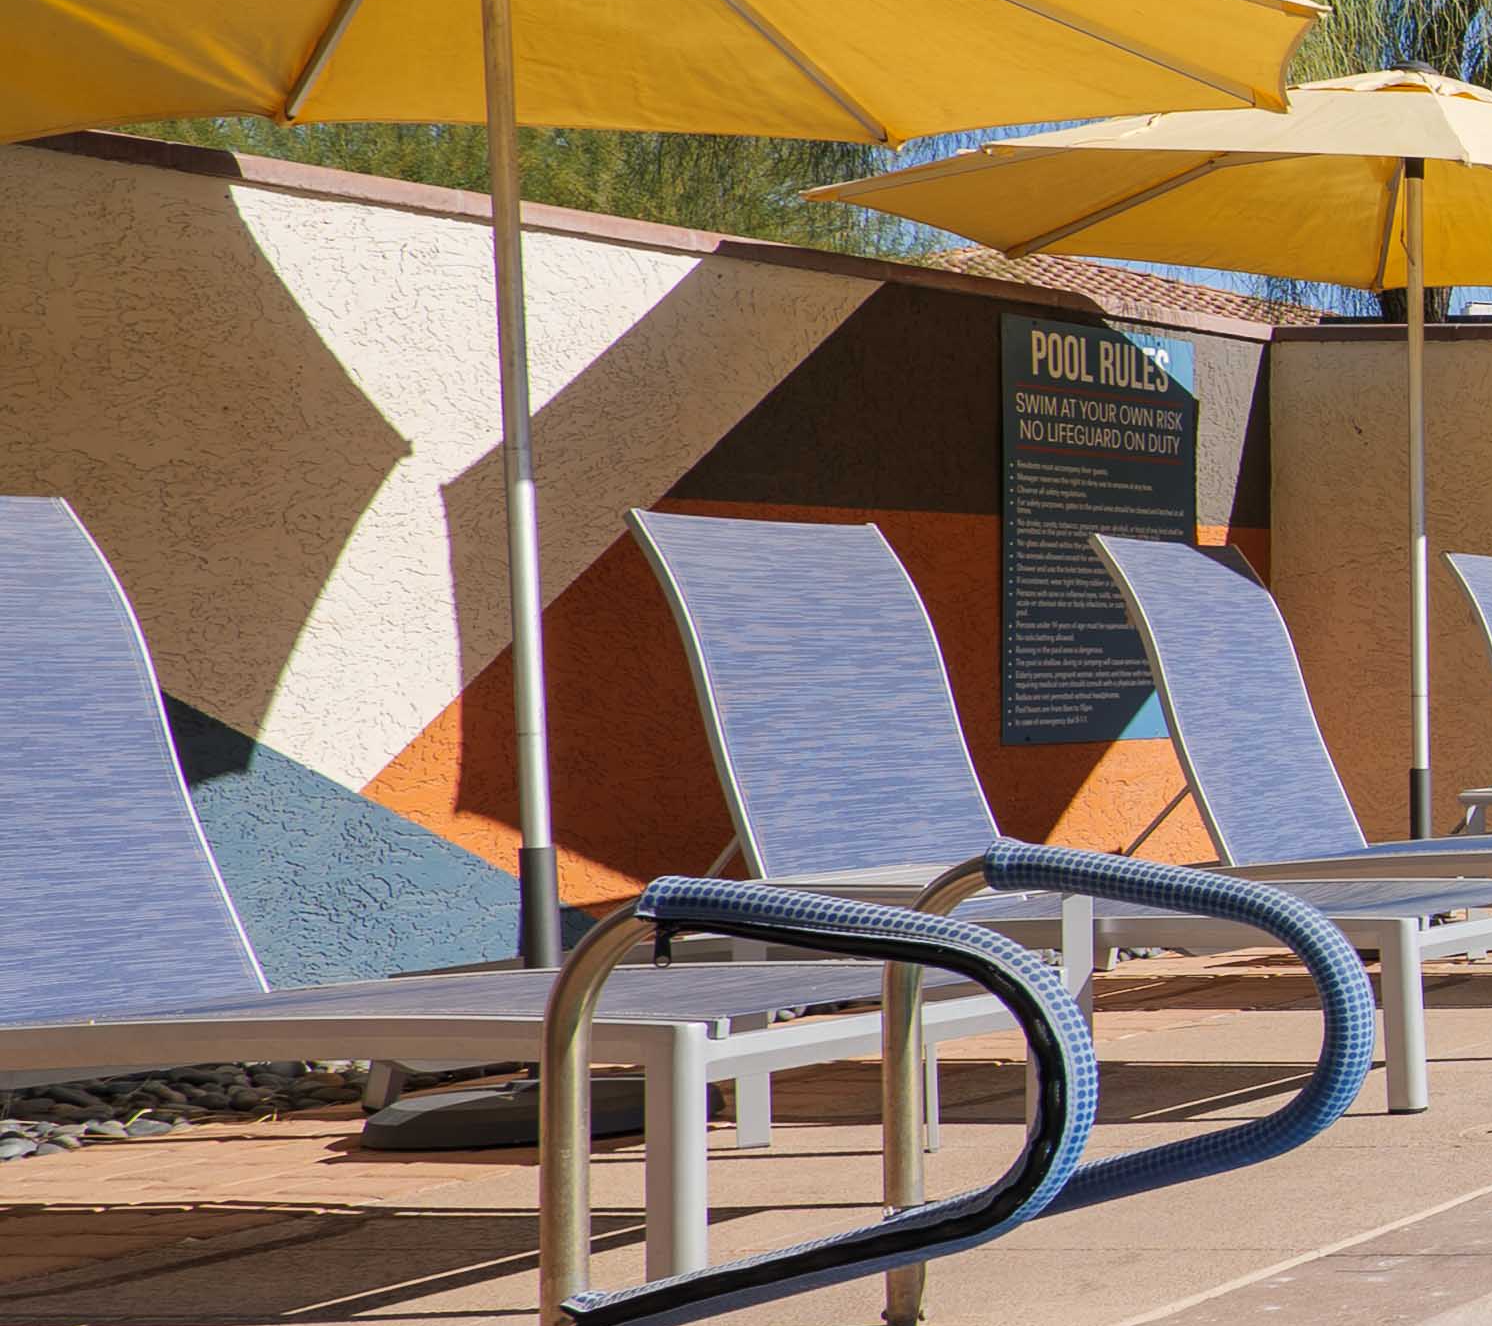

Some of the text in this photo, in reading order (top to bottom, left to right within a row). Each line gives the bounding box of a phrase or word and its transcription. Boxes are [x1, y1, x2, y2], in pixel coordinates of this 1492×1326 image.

[1031, 330, 1169, 393] POOL RULES
[1016, 392, 1183, 432] SWIM AT YOUR OWN RISK
[1019, 419, 1181, 456] NO LIFEGUARD ON DUTY
